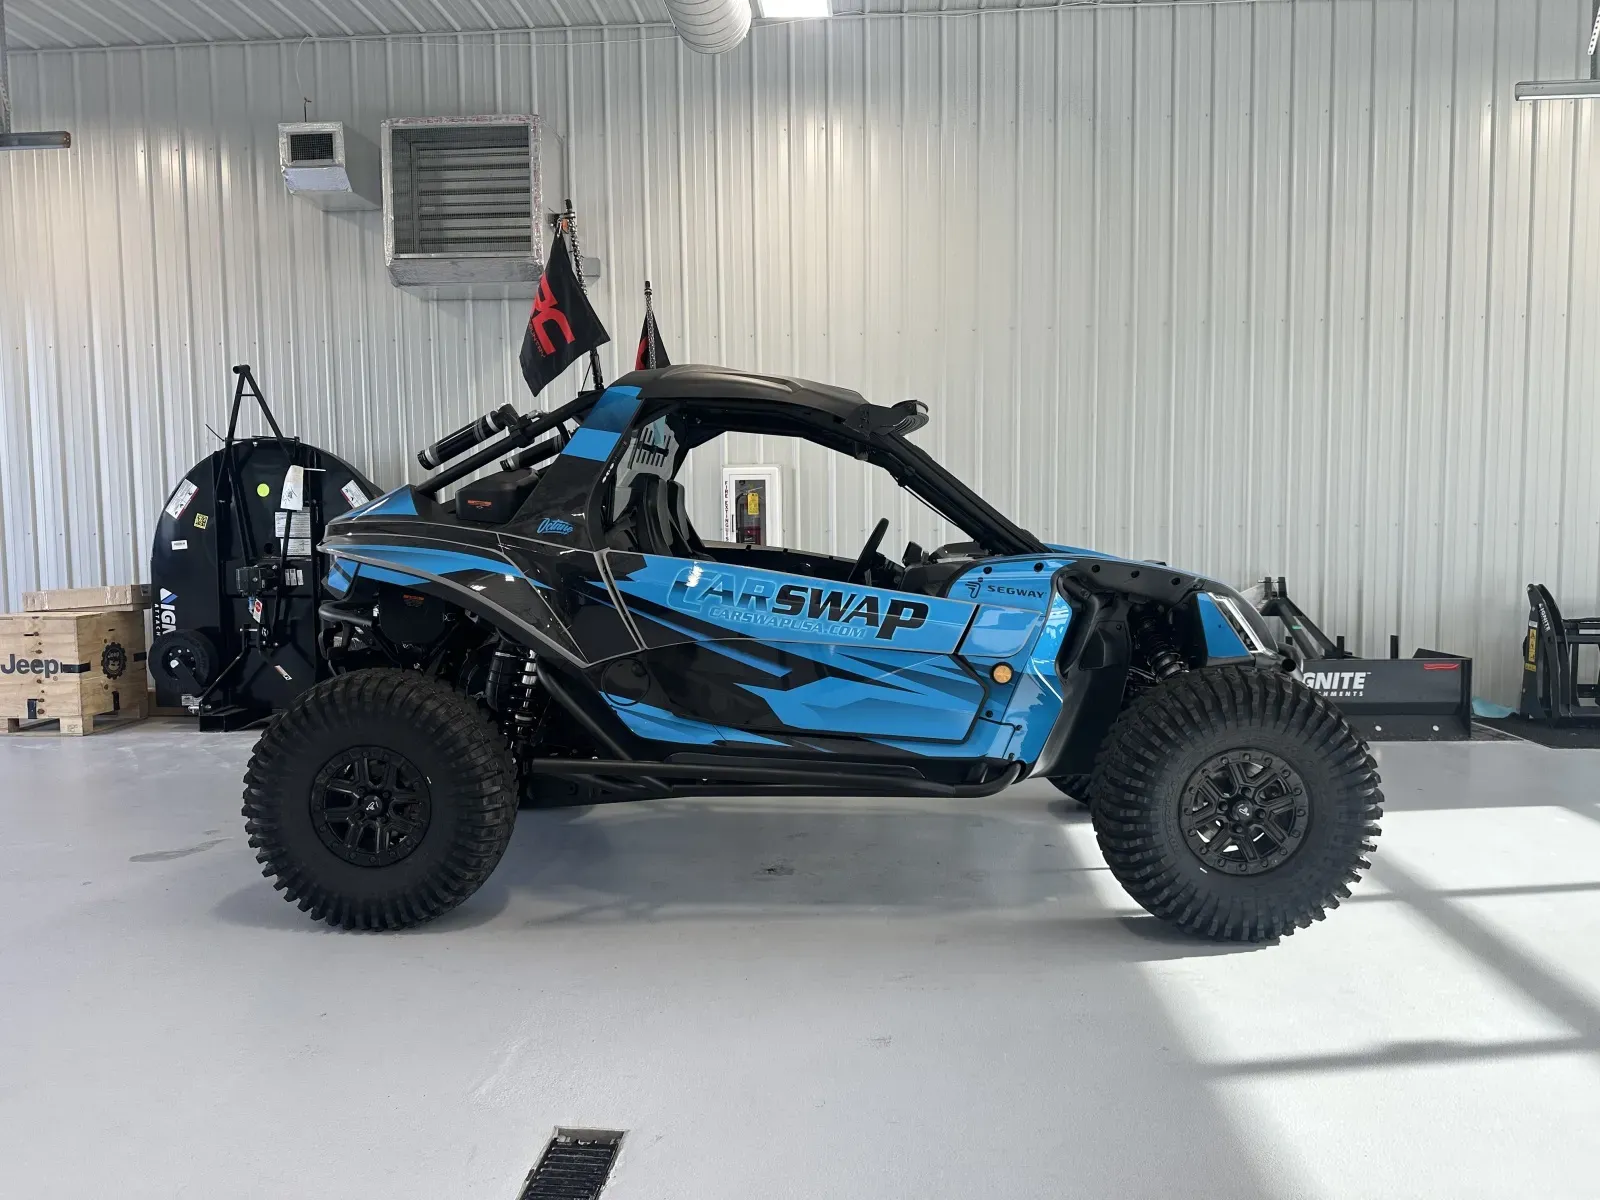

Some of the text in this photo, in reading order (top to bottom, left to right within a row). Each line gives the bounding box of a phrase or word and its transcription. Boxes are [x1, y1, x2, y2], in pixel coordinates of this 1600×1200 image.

[666, 566, 930, 641] CARSWAP
[987, 584, 1044, 599] SEGWAY
[708, 605, 867, 640] CARSWAPUSA.COM
[0, 653, 59, 679] Jeep
